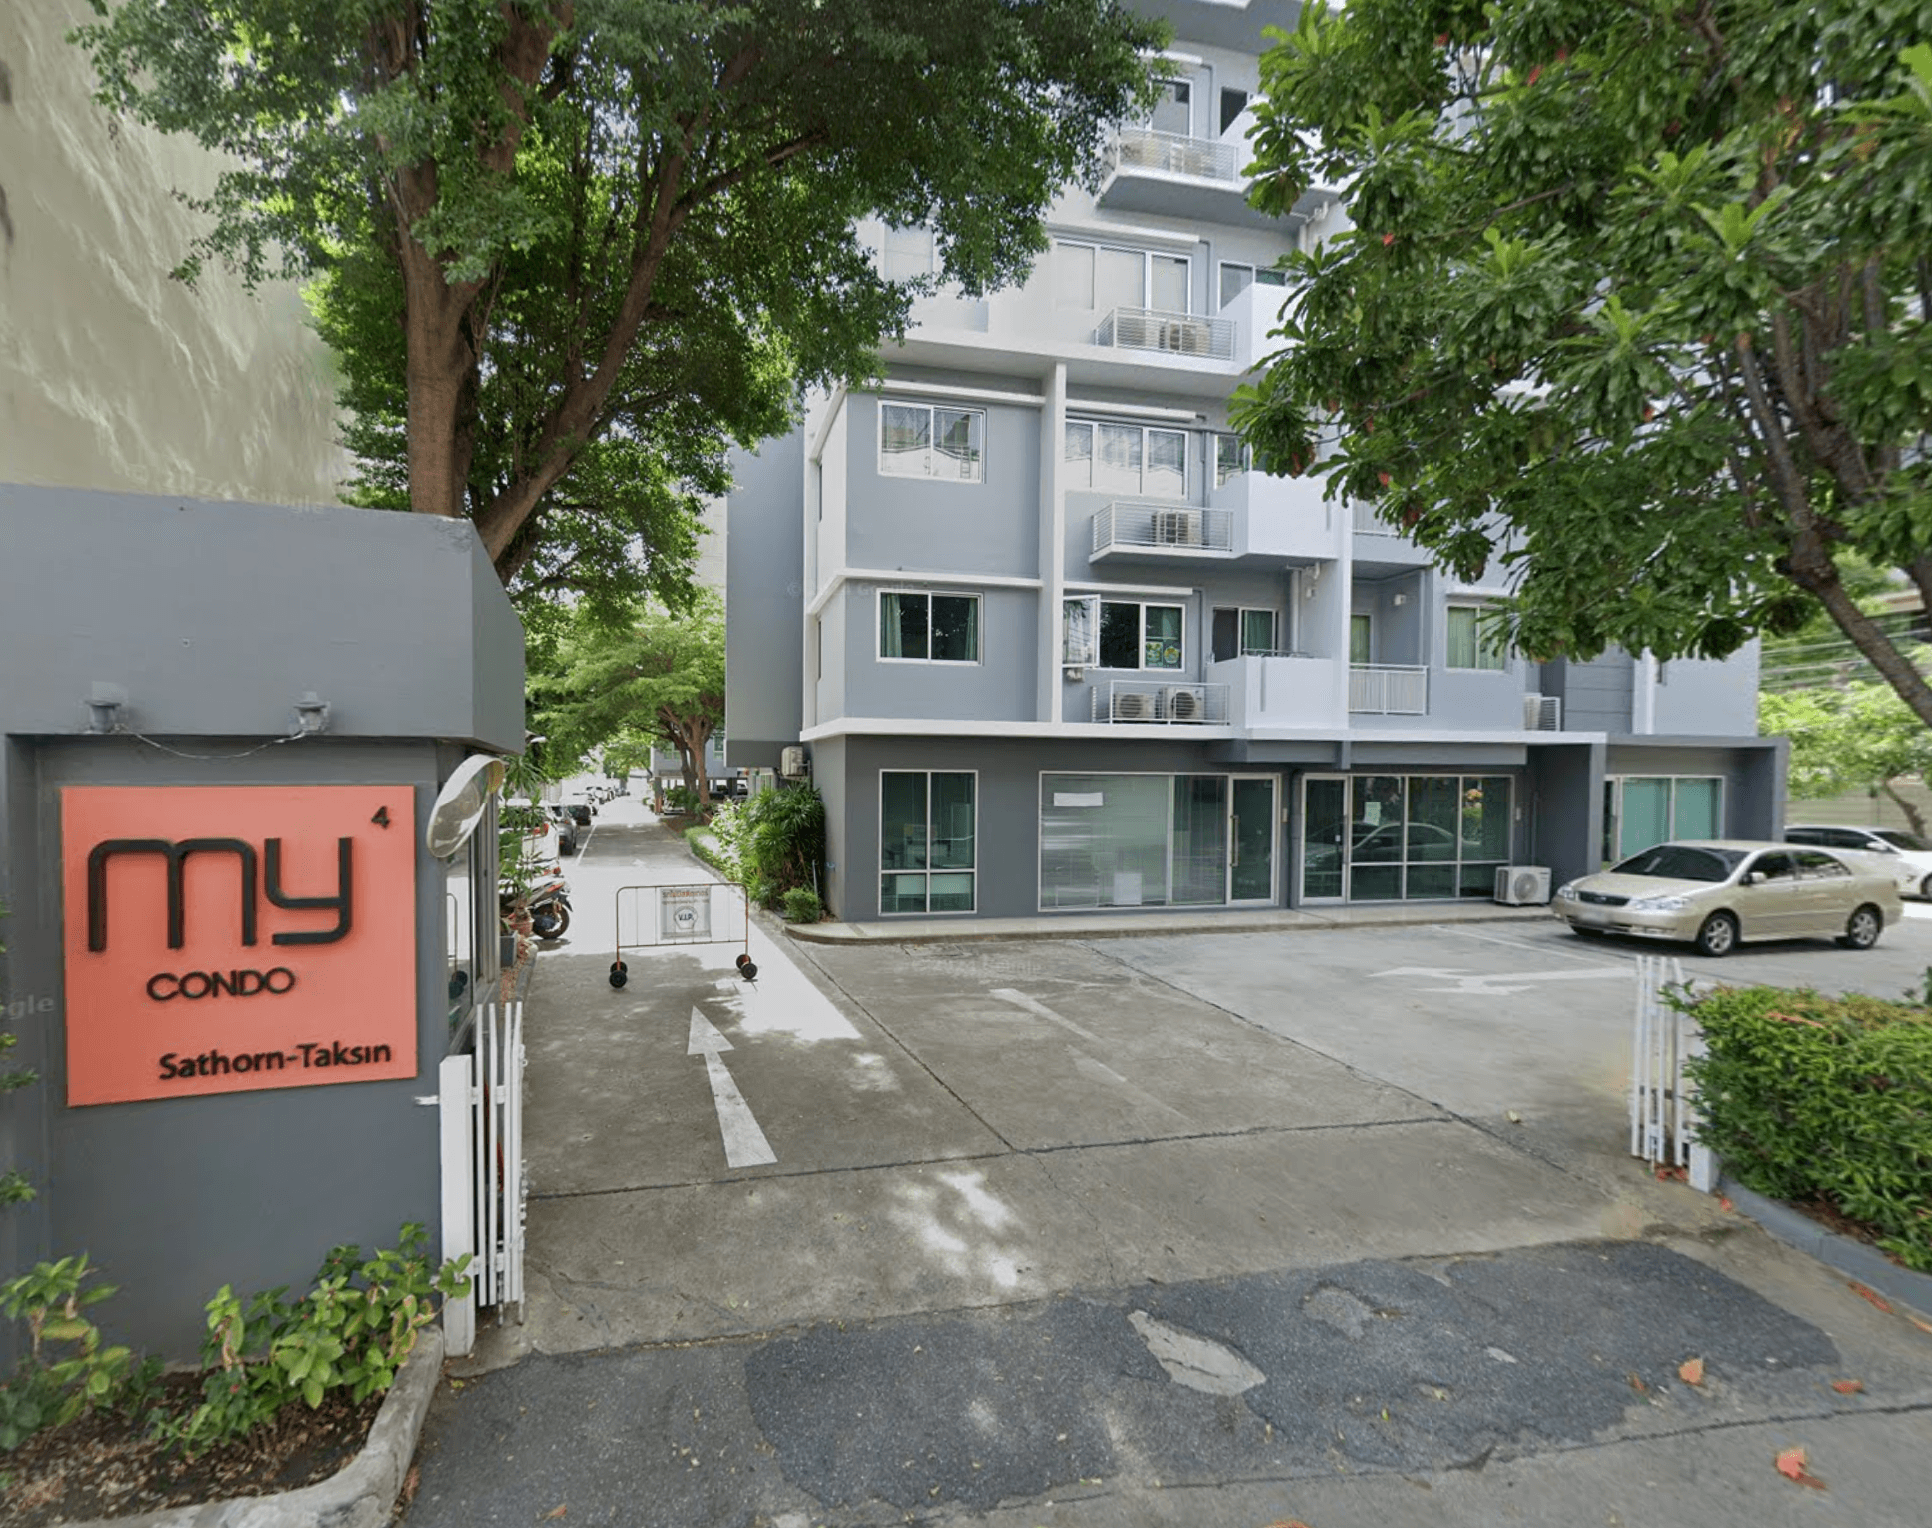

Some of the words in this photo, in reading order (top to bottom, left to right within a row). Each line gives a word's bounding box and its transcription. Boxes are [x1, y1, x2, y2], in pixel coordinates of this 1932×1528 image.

[370, 804, 391, 829] 4
[146, 966, 297, 1001] CONDO
[158, 1040, 392, 1080] Sathorn-Taksin
